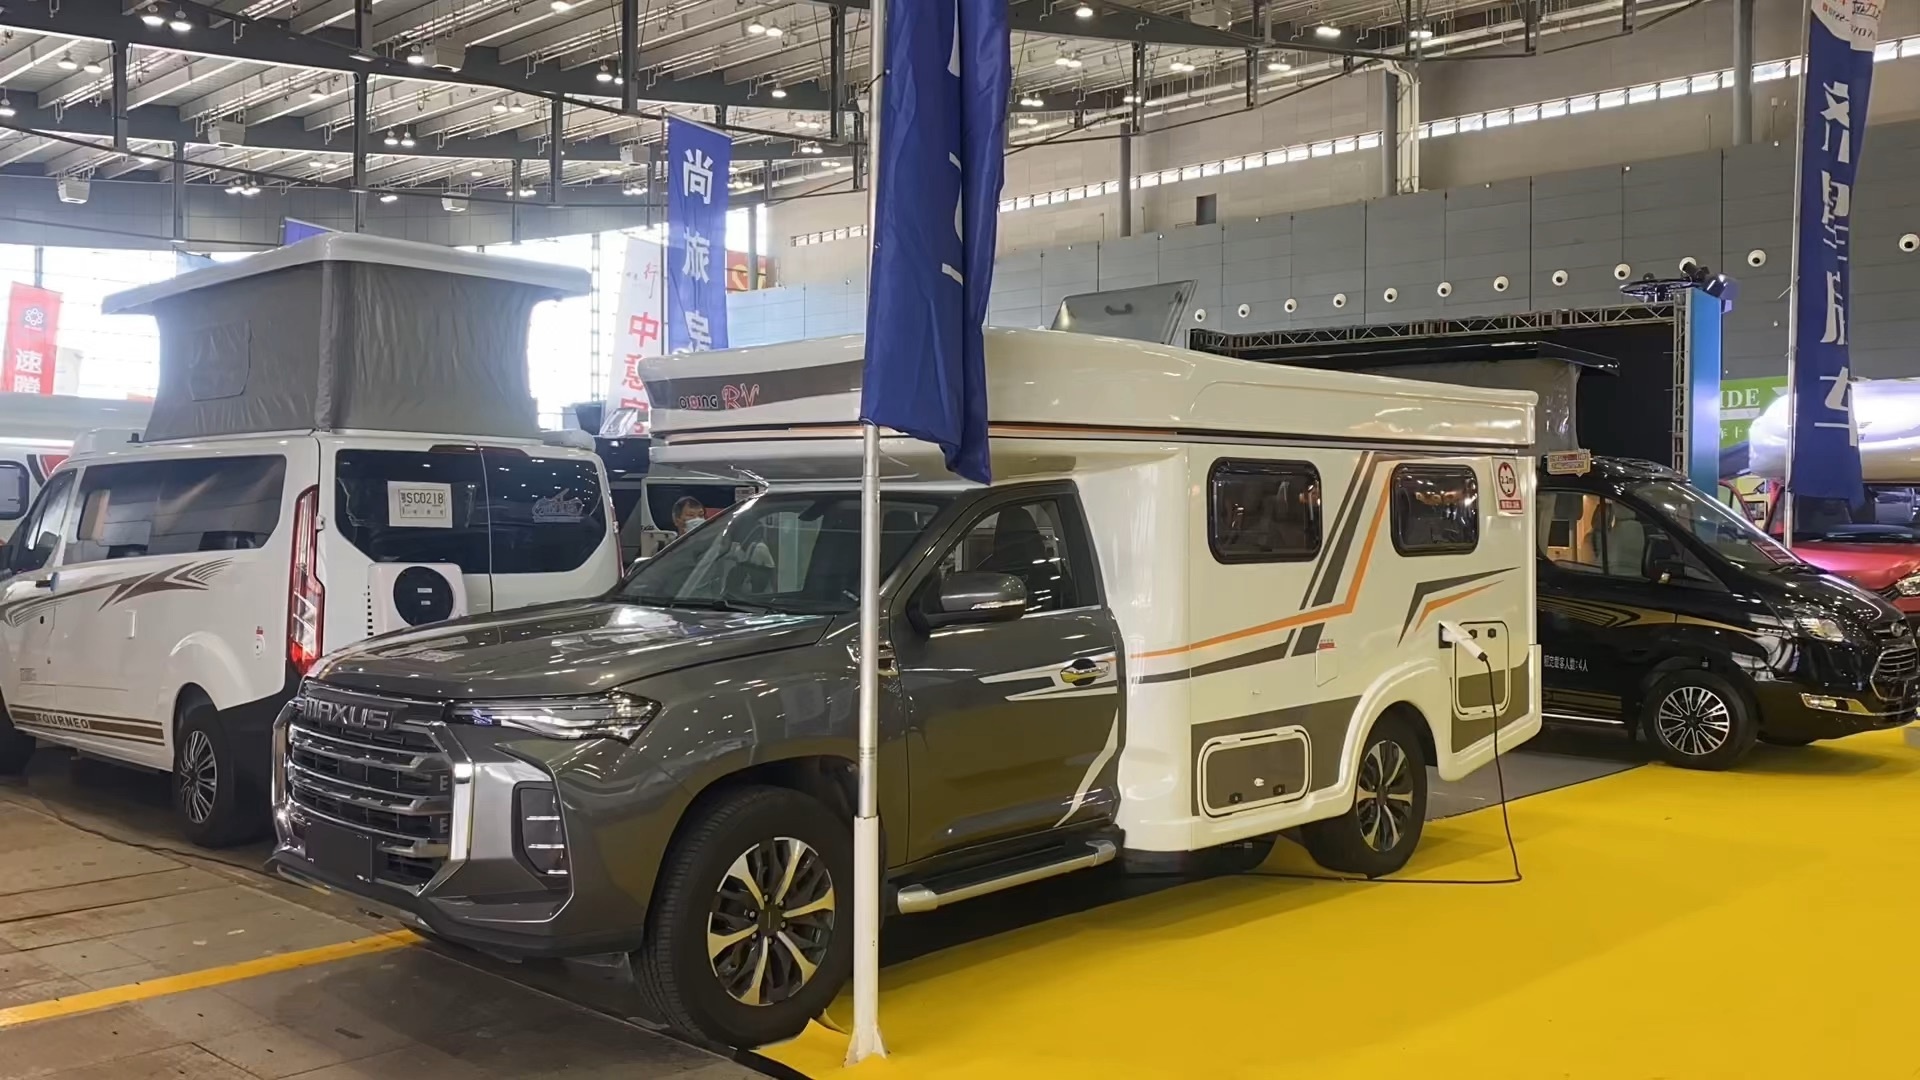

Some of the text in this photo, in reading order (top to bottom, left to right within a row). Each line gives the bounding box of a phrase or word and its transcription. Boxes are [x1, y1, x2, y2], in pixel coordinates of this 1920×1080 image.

[722, 383, 760, 409] RV
[1720, 388, 1760, 408] IDE
[34, 713, 90, 729] TOURNEO
[304, 697, 389, 729] MAXUS
